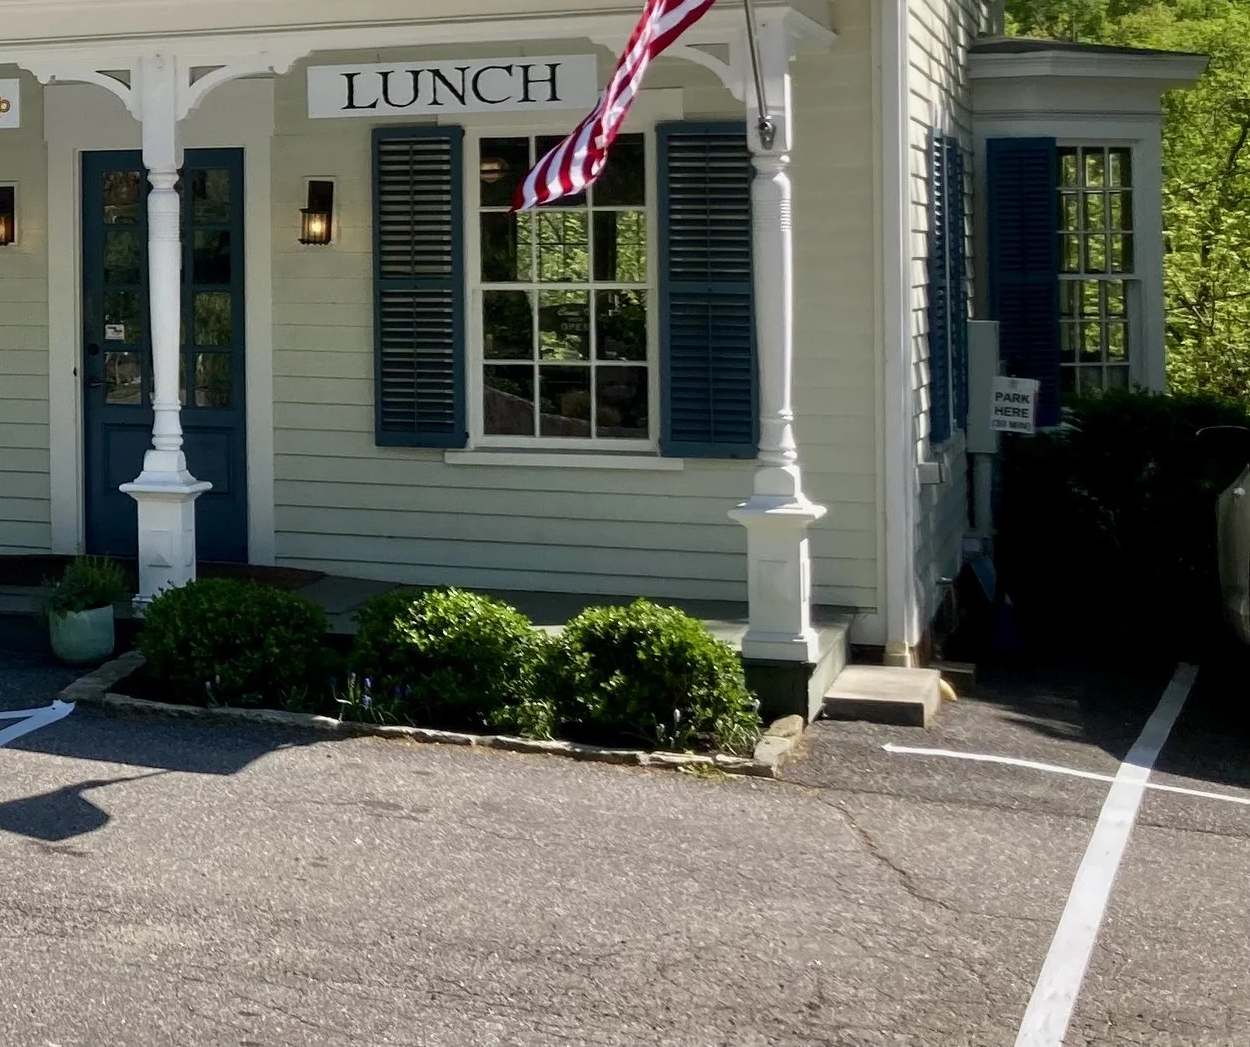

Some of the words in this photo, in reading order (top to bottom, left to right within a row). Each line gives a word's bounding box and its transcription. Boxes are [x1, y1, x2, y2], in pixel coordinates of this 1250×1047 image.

[340, 63, 562, 110] LUNCH
[995, 391, 1030, 404] PARK
[994, 406, 1029, 419] HERE
